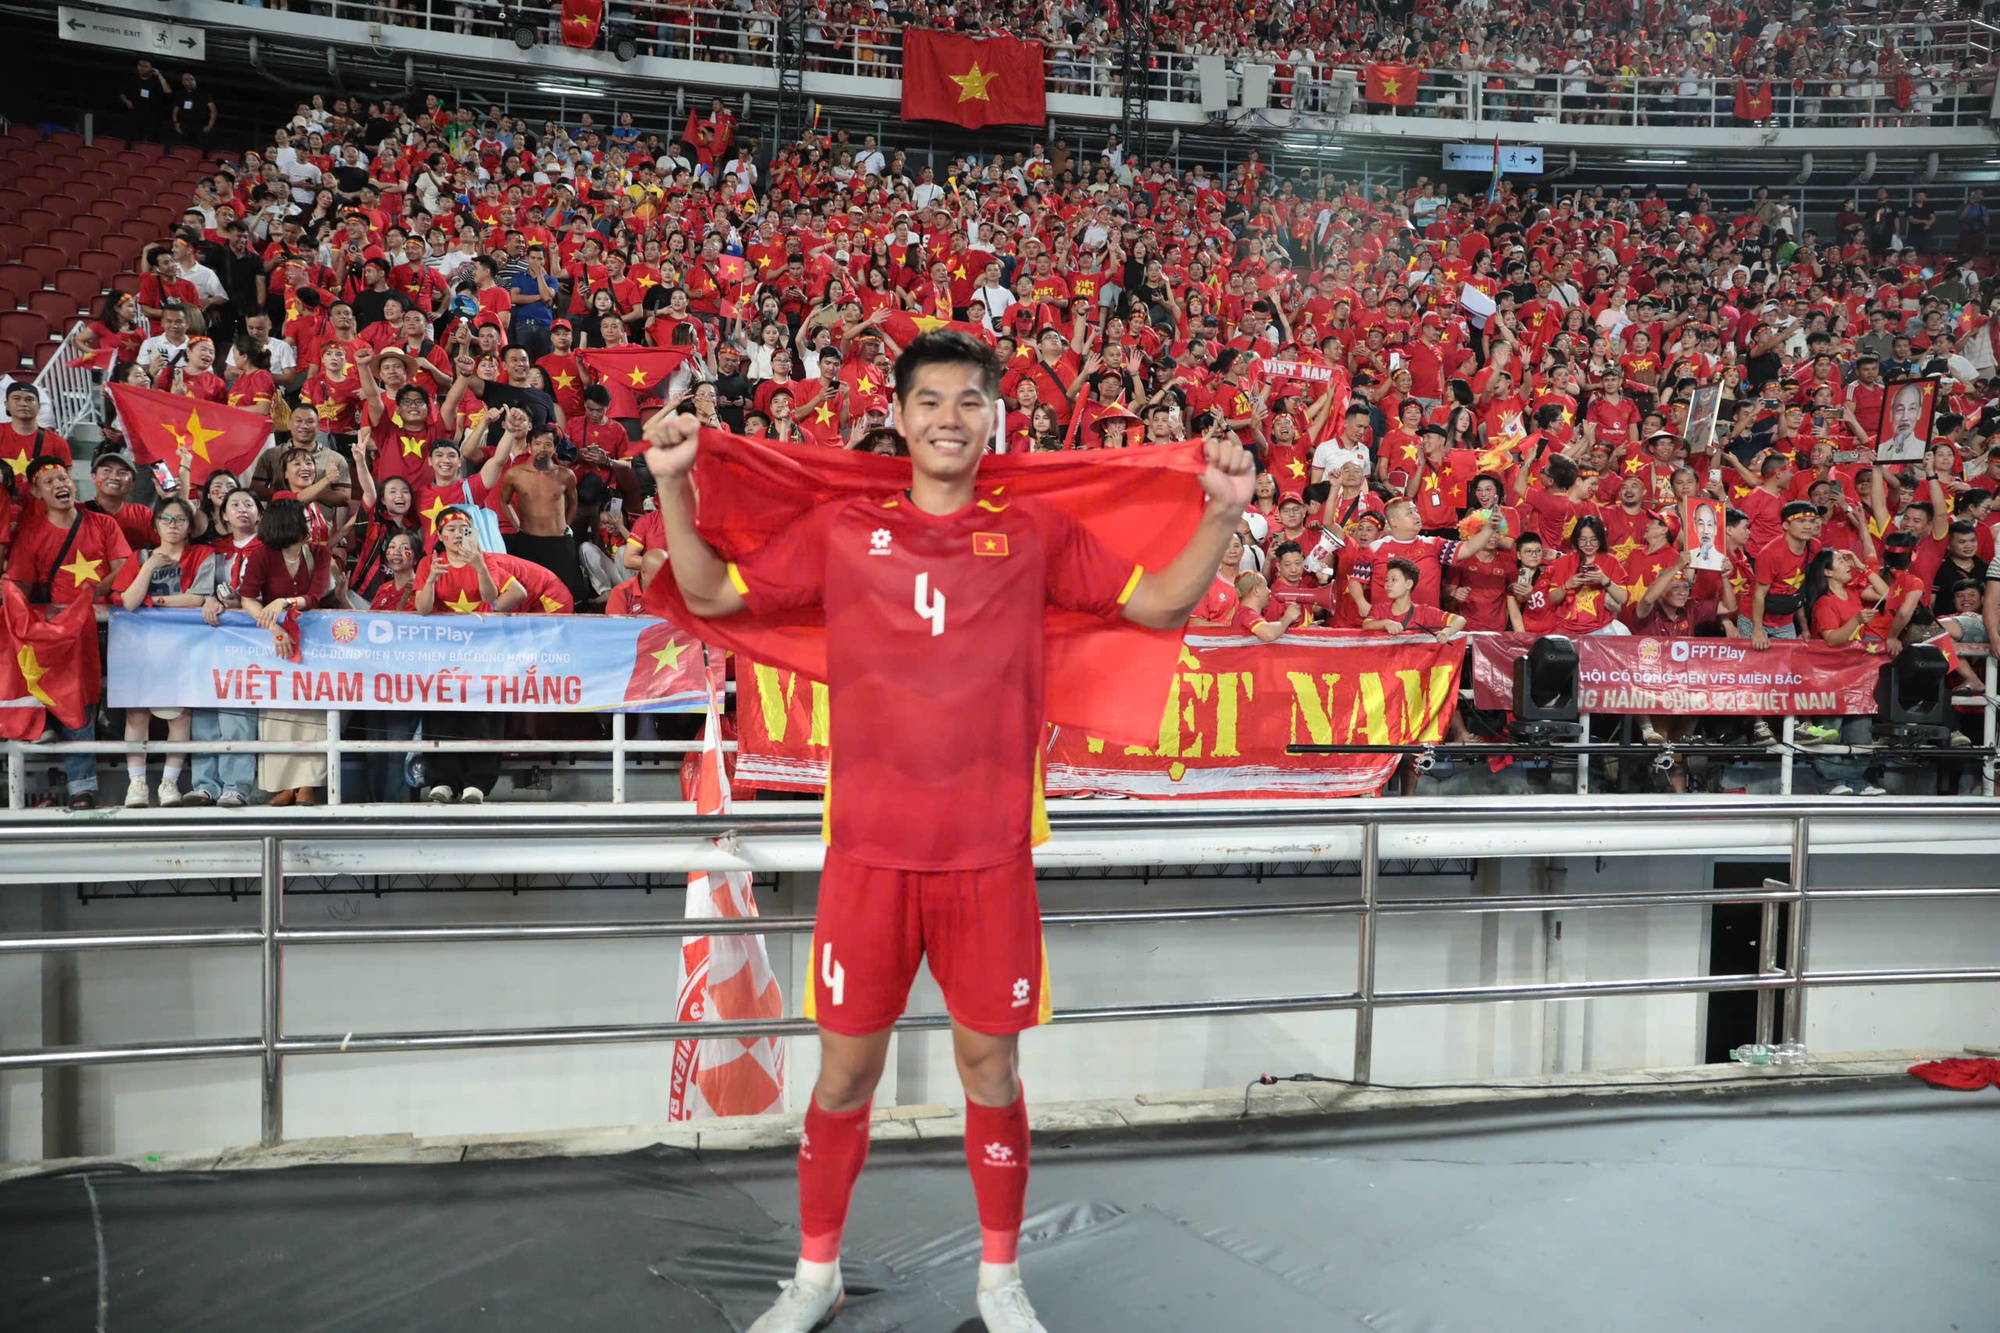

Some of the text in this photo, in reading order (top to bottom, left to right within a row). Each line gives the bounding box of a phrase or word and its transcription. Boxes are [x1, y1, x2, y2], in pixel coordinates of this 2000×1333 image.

[123, 29, 142, 38] EXIT
[1300, 364, 1333, 380] NAM
[914, 572, 946, 637] 4
[397, 625, 474, 645] FPT Play
[394, 651, 415, 661] VFS
[1691, 645, 1746, 662] FPT Play
[212, 663, 582, 705] VIỆT NAM QUYẾT THẮNG
[1580, 668, 1606, 684] HỘI
[1709, 673, 1736, 684] VFS
[1286, 664, 1454, 754] NAM
[1603, 686, 1656, 709] HÀNH
[1751, 688, 1789, 713] VIỆT
[1794, 691, 1837, 711] NAM
[821, 942, 845, 1006] 4
